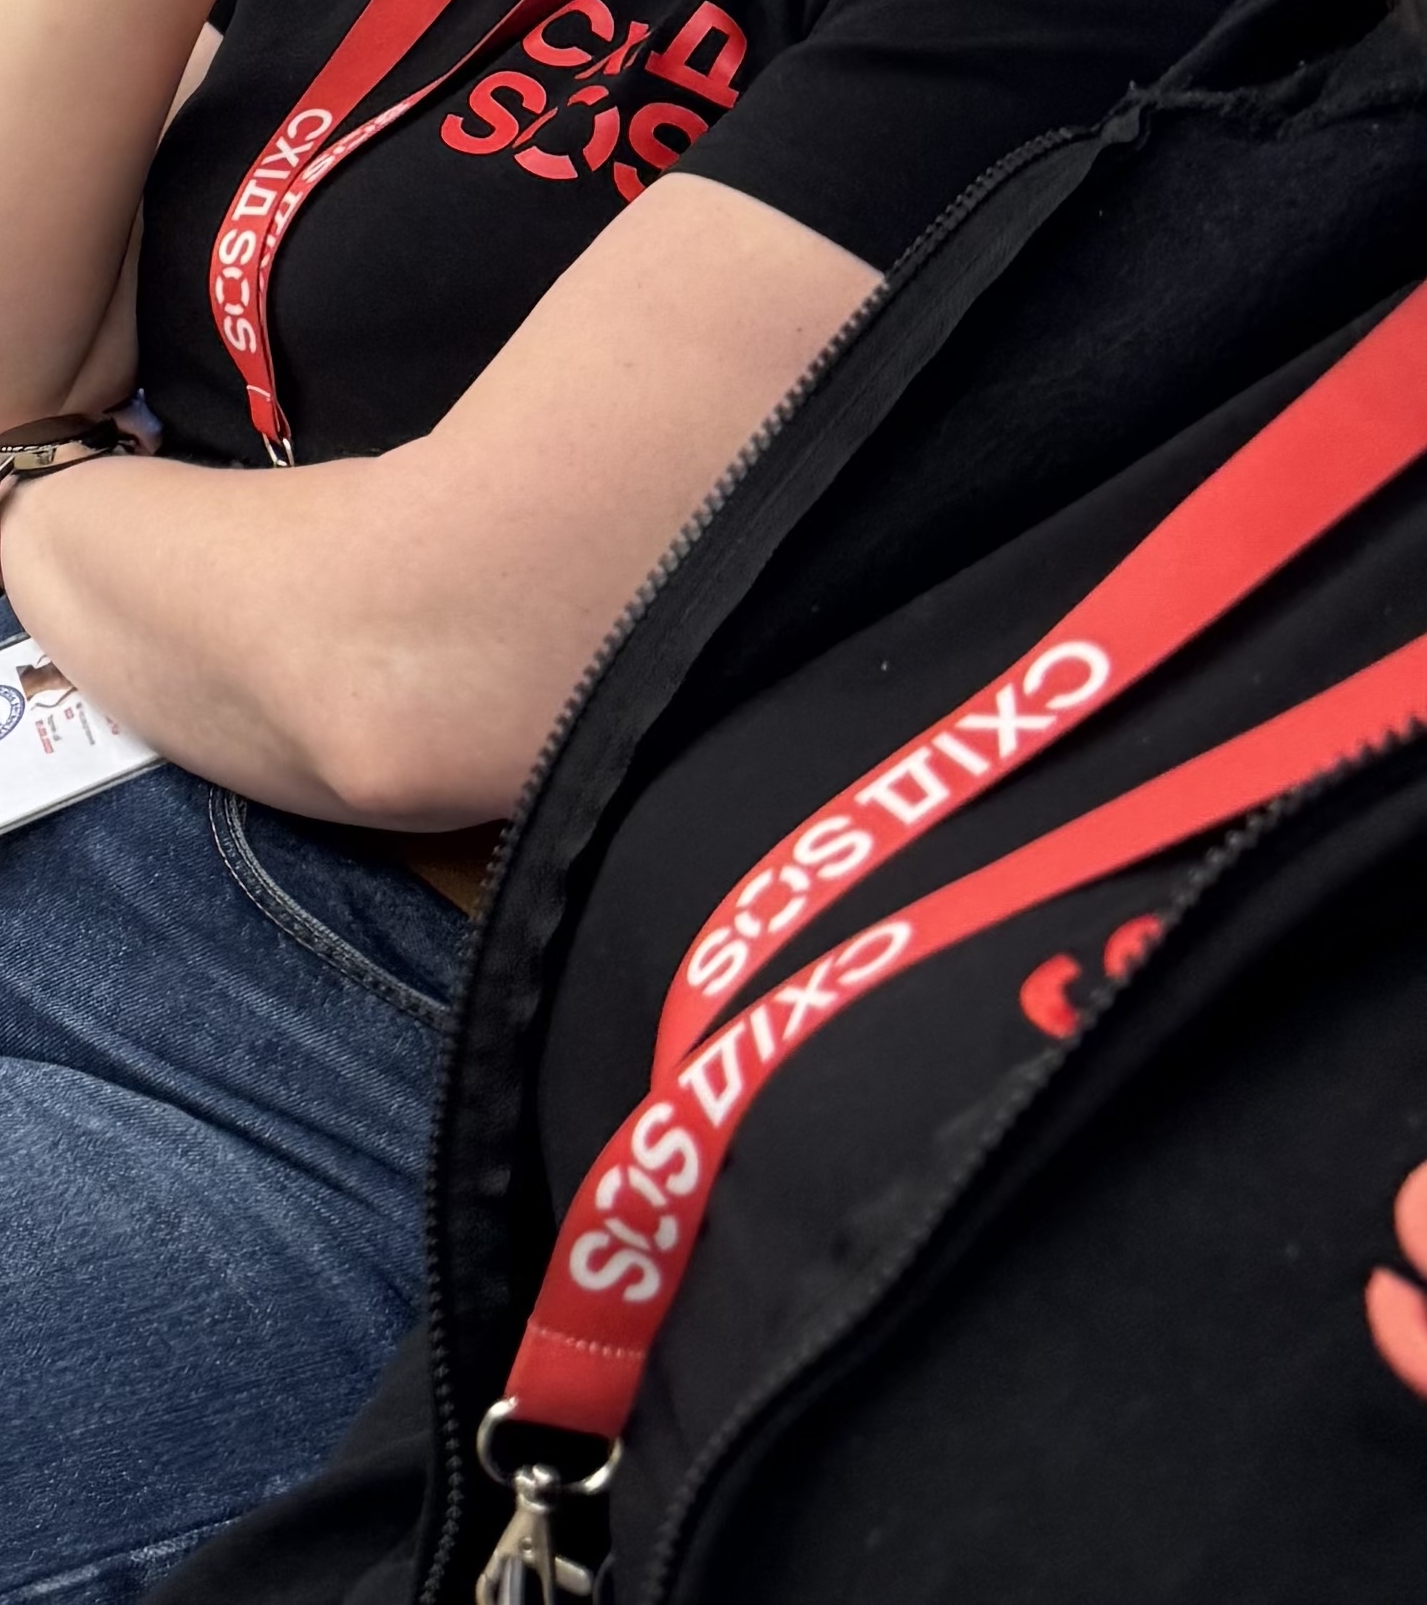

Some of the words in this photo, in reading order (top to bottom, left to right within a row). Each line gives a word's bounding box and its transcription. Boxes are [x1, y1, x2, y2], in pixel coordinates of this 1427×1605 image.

[232, 107, 335, 221] СХІД
[215, 227, 259, 354] SOS
[855, 640, 1113, 829] СХІД
[686, 816, 874, 997] SOS
[677, 919, 915, 1129] СХІД
[568, 1103, 700, 1304] SOS
